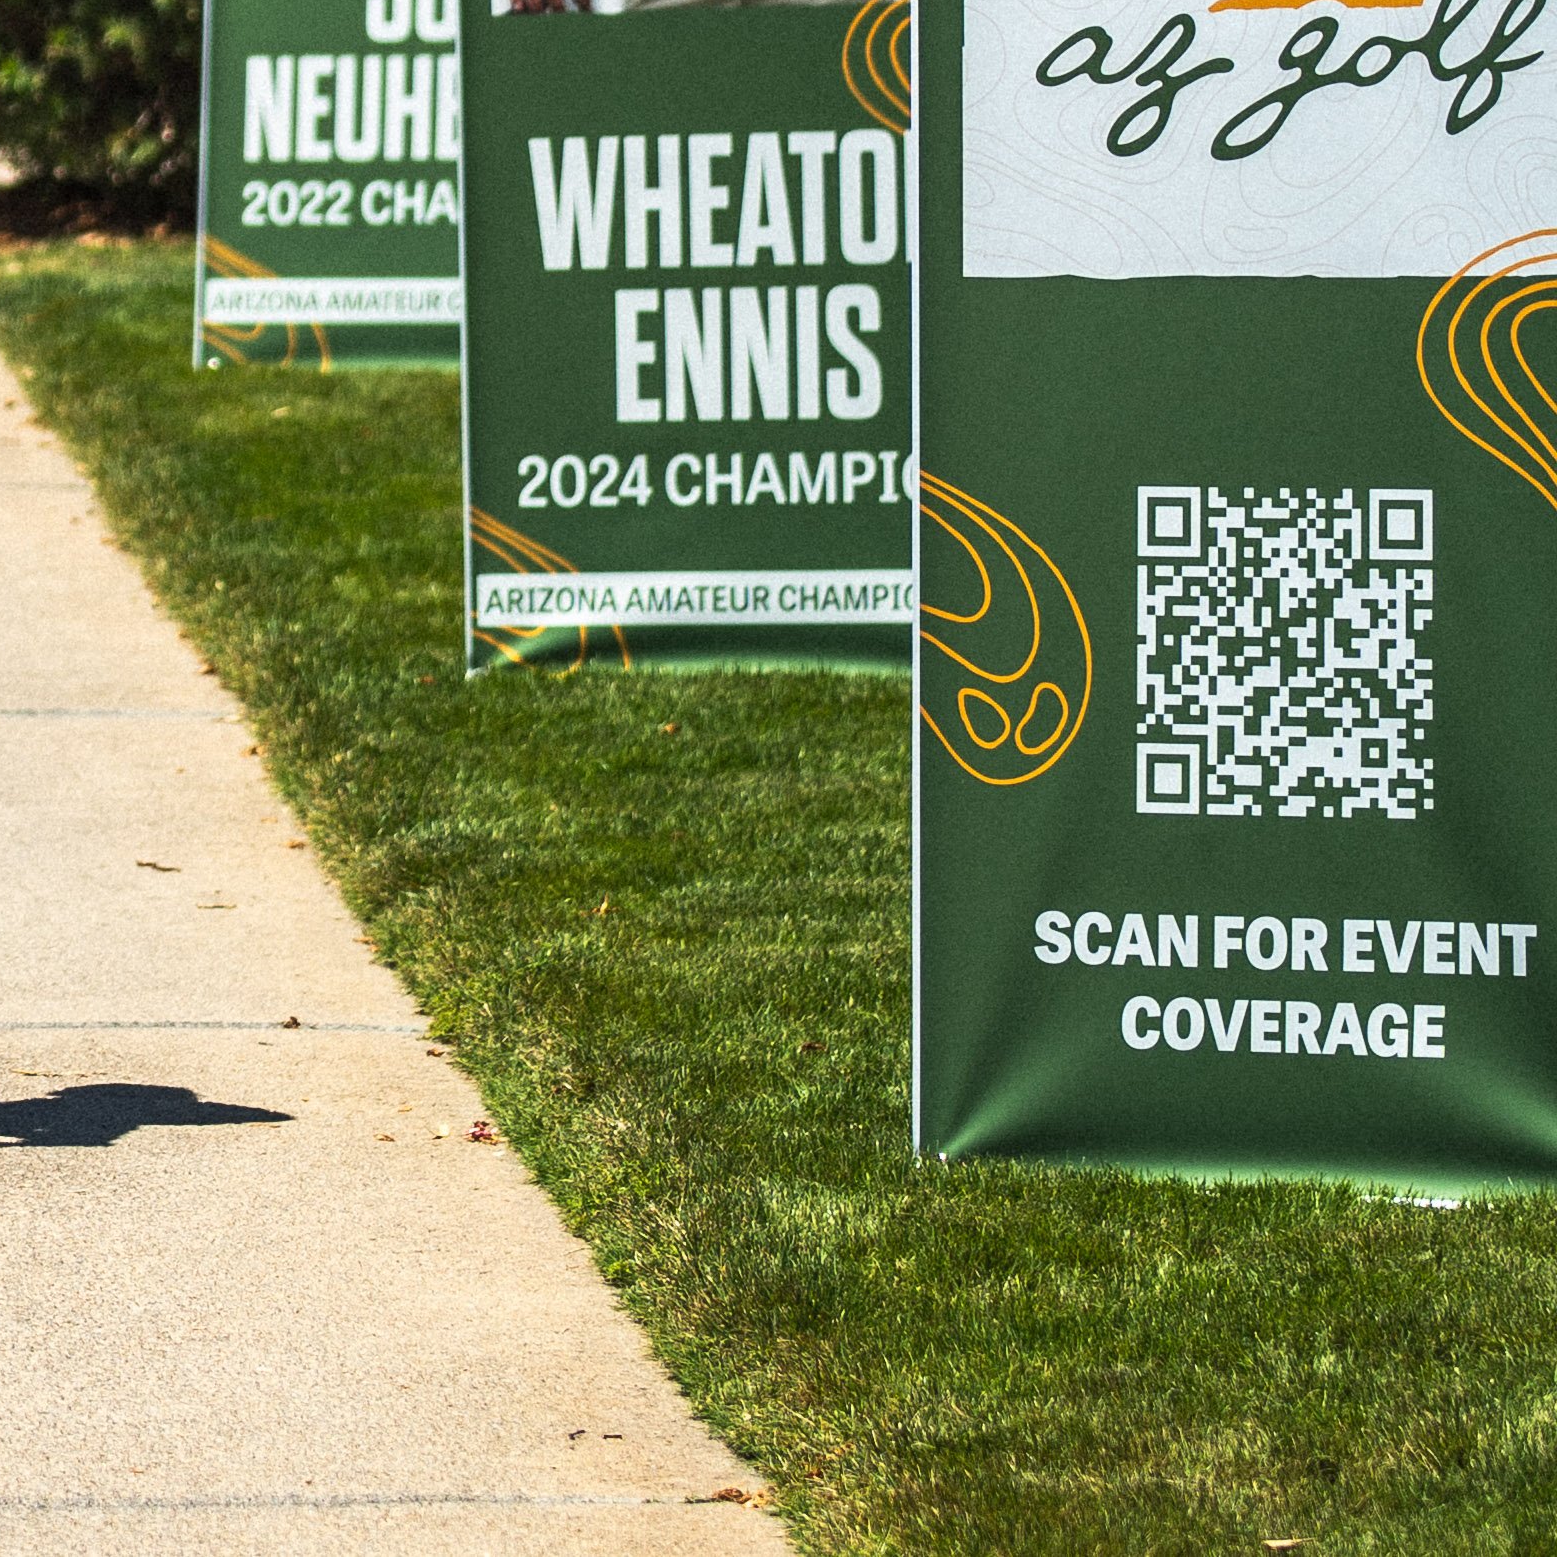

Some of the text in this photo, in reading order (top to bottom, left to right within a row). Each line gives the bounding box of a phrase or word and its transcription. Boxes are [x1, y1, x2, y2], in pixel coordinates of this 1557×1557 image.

[1035, 13, 1234, 157] az
[241, 179, 352, 226] 2022
[527, 128, 913, 271] WHEATO
[211, 290, 318, 313] ARIZONA
[326, 290, 441, 313] AMATEUR
[614, 283, 883, 423] ENNIS
[517, 453, 652, 509] 2024
[484, 586, 618, 614] ARIZONA
[624, 584, 769, 613] AMATEUR
[1033, 910, 1537, 977] SCAN FOR EVENT
[1121, 995, 1445, 1059] COVERAGE
